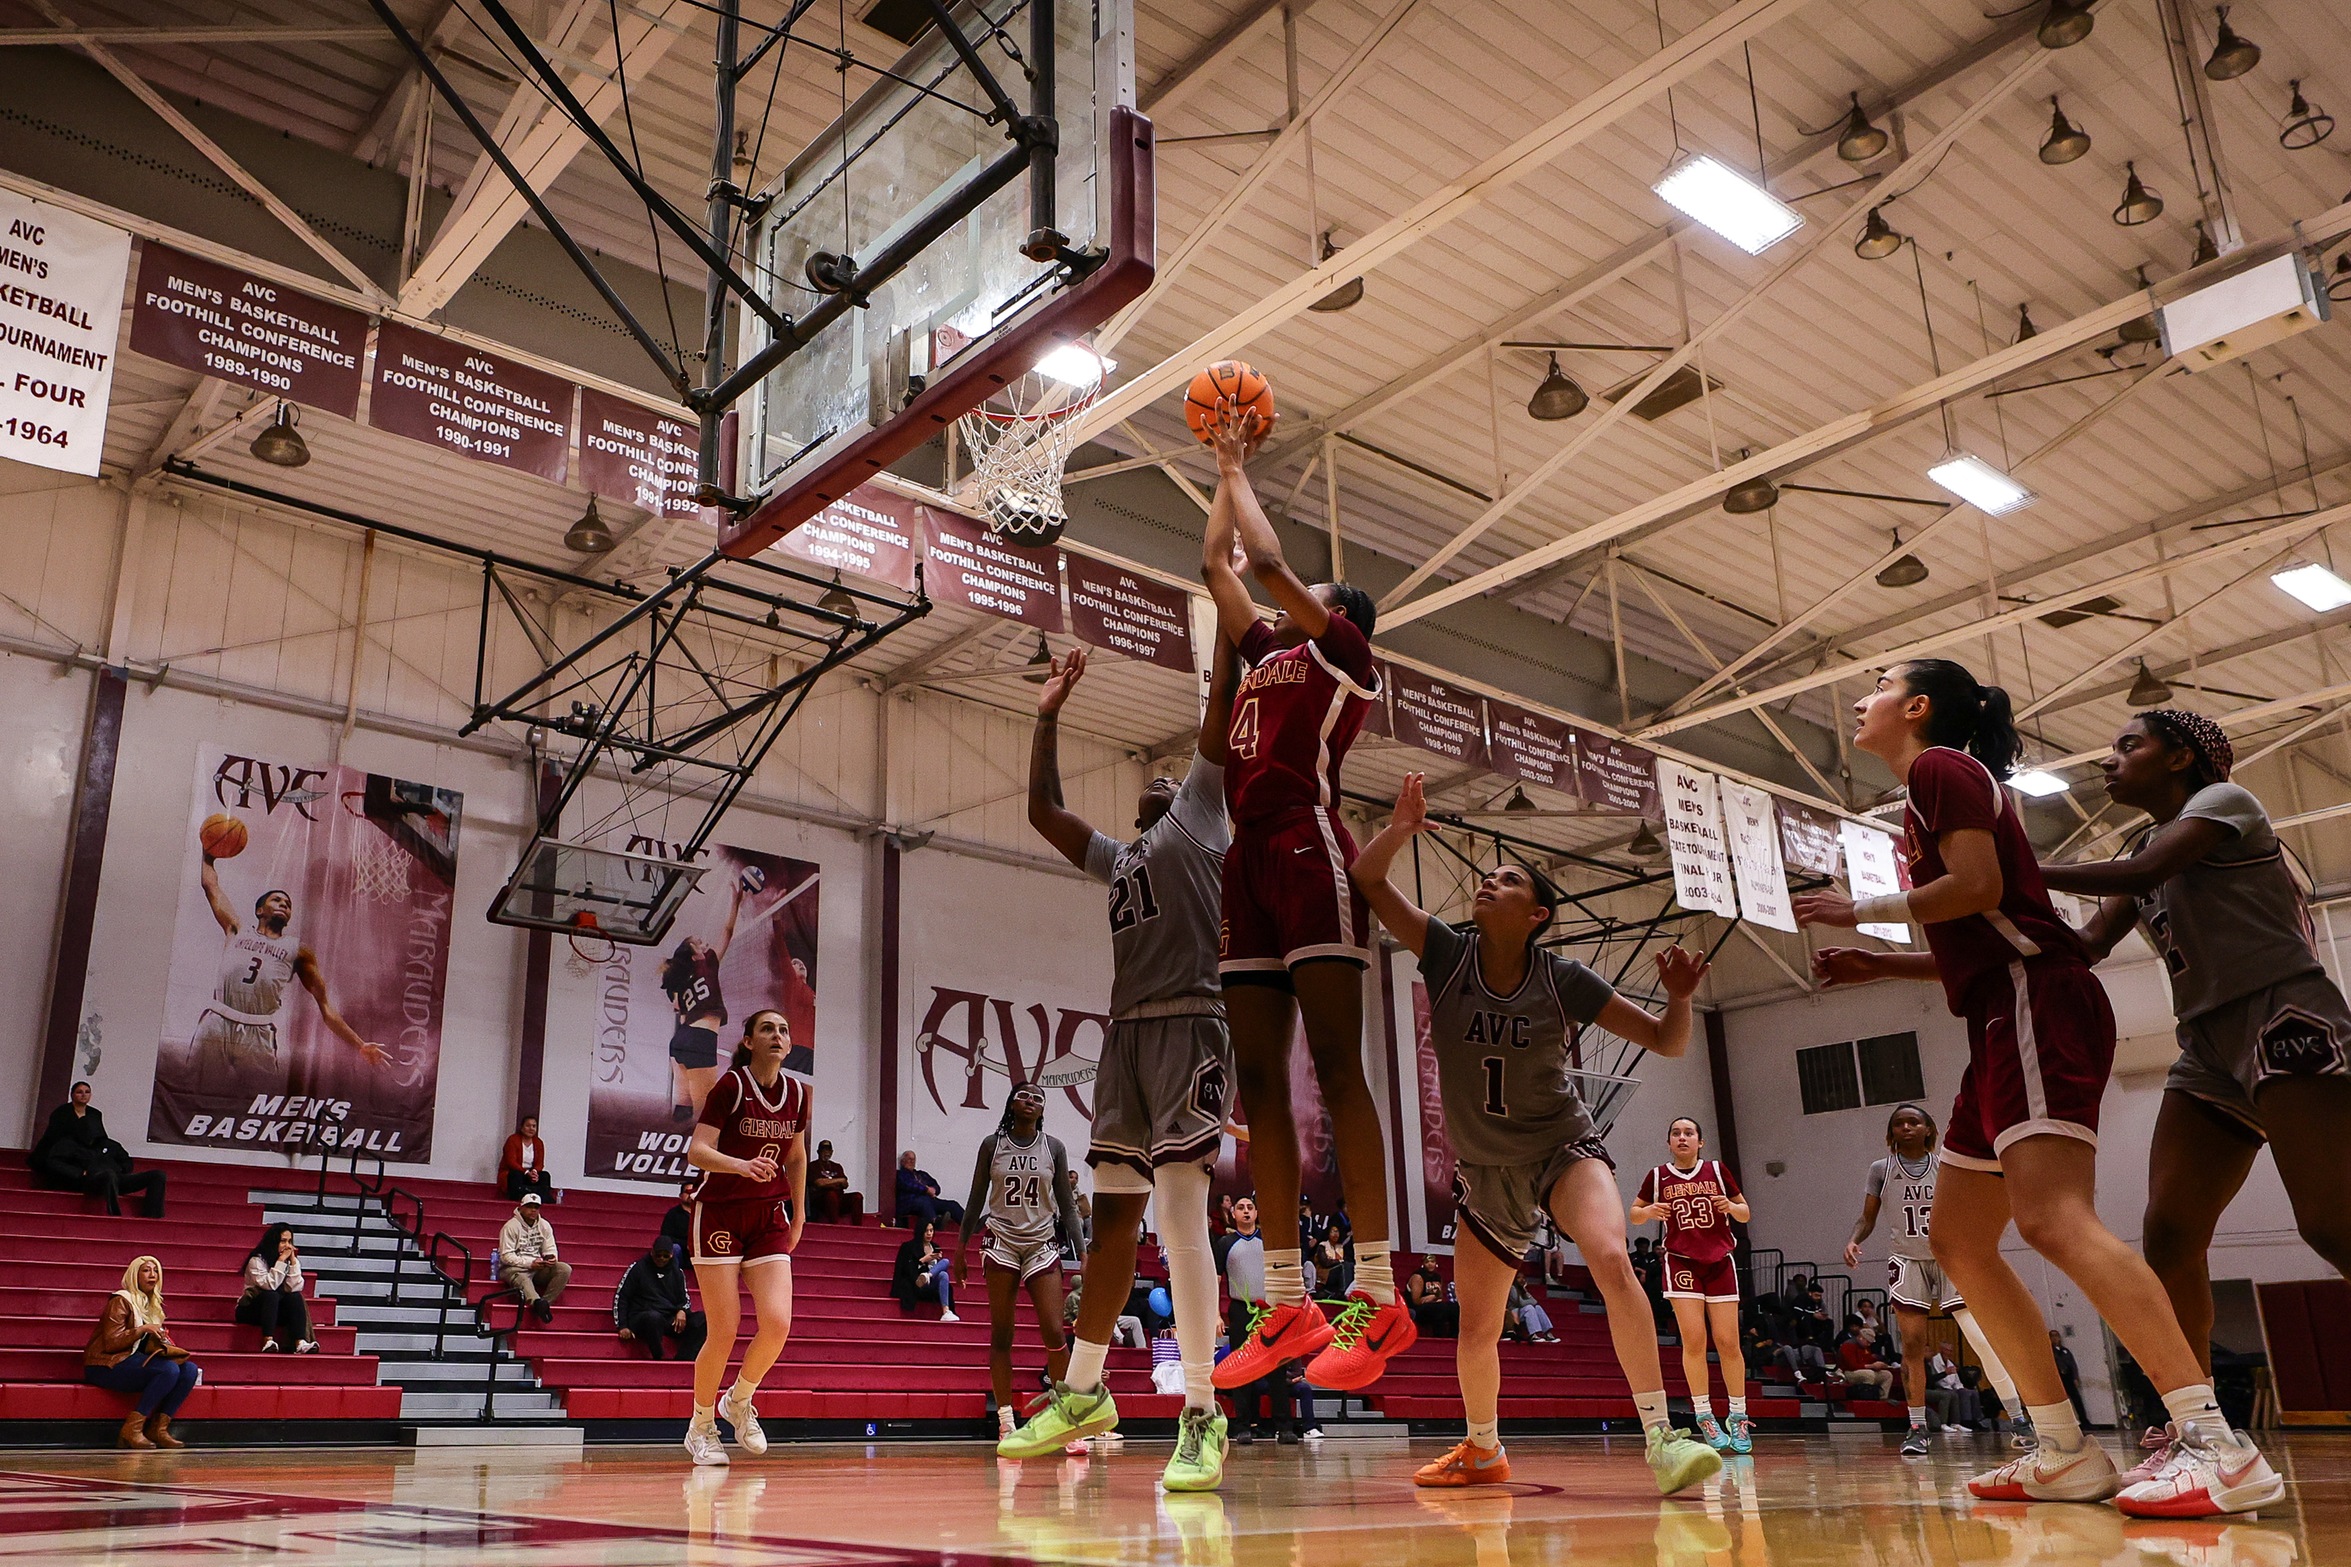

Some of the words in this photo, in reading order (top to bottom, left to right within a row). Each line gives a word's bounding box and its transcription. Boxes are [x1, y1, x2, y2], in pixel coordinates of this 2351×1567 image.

[9, 219, 45, 246] AVC
[242, 281, 276, 302] AVC
[167, 275, 223, 305] MEN'S
[230, 296, 340, 345] BASKETBALL
[145, 292, 235, 332] FOOTHILL
[241, 322, 356, 369] CONFERENCE
[198, 329, 303, 374] CHAMPIONS
[464, 356, 495, 376] AVC
[204, 352, 291, 391] 1989-1990
[402, 353, 450, 380] MEN'S
[454, 370, 551, 413] BASKETBALL
[14, 372, 86, 409] FOUR
[383, 369, 461, 405] FOOTHILL
[463, 395, 564, 437] CONFERENCE
[429, 402, 521, 441] CHAMPIONS
[603, 419, 645, 443] MEN'S
[656, 420, 682, 437] AVC
[436, 425, 511, 458] 1990-1991
[587, 434, 655, 466] FOOTHILL
[635, 485, 700, 513] 1991-1992
[802, 523, 876, 554] CHAMPIONS
[829, 515, 910, 549] CONFERENCE
[982, 531, 1004, 546] AVC
[808, 543, 871, 569] 1994-1995
[939, 532, 974, 553] MEN'S
[976, 545, 1045, 576] BASKETBALL
[930, 546, 985, 573] FOOTHILL
[986, 564, 1056, 595] CONFERENCE
[1119, 576, 1139, 590] AVC
[962, 572, 1027, 601] CHAMPIONS
[1082, 579, 1113, 598] MEN'S
[1114, 590, 1177, 618] BASKETBALL
[968, 591, 1024, 616] 1995-1996
[1073, 592, 1121, 617] FOOTHILL
[1123, 608, 1185, 637] CONFERENCE
[1103, 617, 1161, 643] CHAMPIONS
[1109, 634, 1156, 658] 1996-1997
[1397, 698, 1432, 720] FOOTHILL
[1433, 713, 1481, 737] CONFERENCE
[1402, 687, 1427, 704] MEN'S
[1427, 696, 1476, 720] BASKETBALL
[1229, 698, 1260, 759] 4
[1418, 721, 1464, 743] CHAMPIONS
[1522, 728, 1562, 749] BASKETBALL
[1514, 752, 1554, 772] CHAMPIONS
[1528, 745, 1571, 765] CONFERENCE
[1607, 757, 1649, 776] BASKETBALL
[214, 753, 328, 823] AVC
[1677, 774, 1698, 793] AVC
[1108, 863, 1160, 936] 21
[242, 957, 262, 984] 3
[393, 888, 449, 1089] MARAUDERS
[682, 977, 710, 1012] 25
[1464, 1009, 1532, 1050] AVC
[1041, 1065, 1097, 1086] MARAUDERS
[1481, 1056, 1509, 1118] 1
[247, 1094, 351, 1122] MEN'S
[184, 1114, 402, 1152] BASKETBALL
[740, 1118, 798, 1138] GLENDALE
[1008, 1155, 1038, 1171] AVC
[1004, 1175, 1041, 1208] 24
[1662, 1180, 1718, 1201] GLENDALE
[1903, 1184, 1934, 1202] AVC
[1671, 1196, 1714, 1231] 23
[1901, 1204, 1932, 1238] 13
[707, 1230, 734, 1255] G
[1674, 1270, 1695, 1290] G
